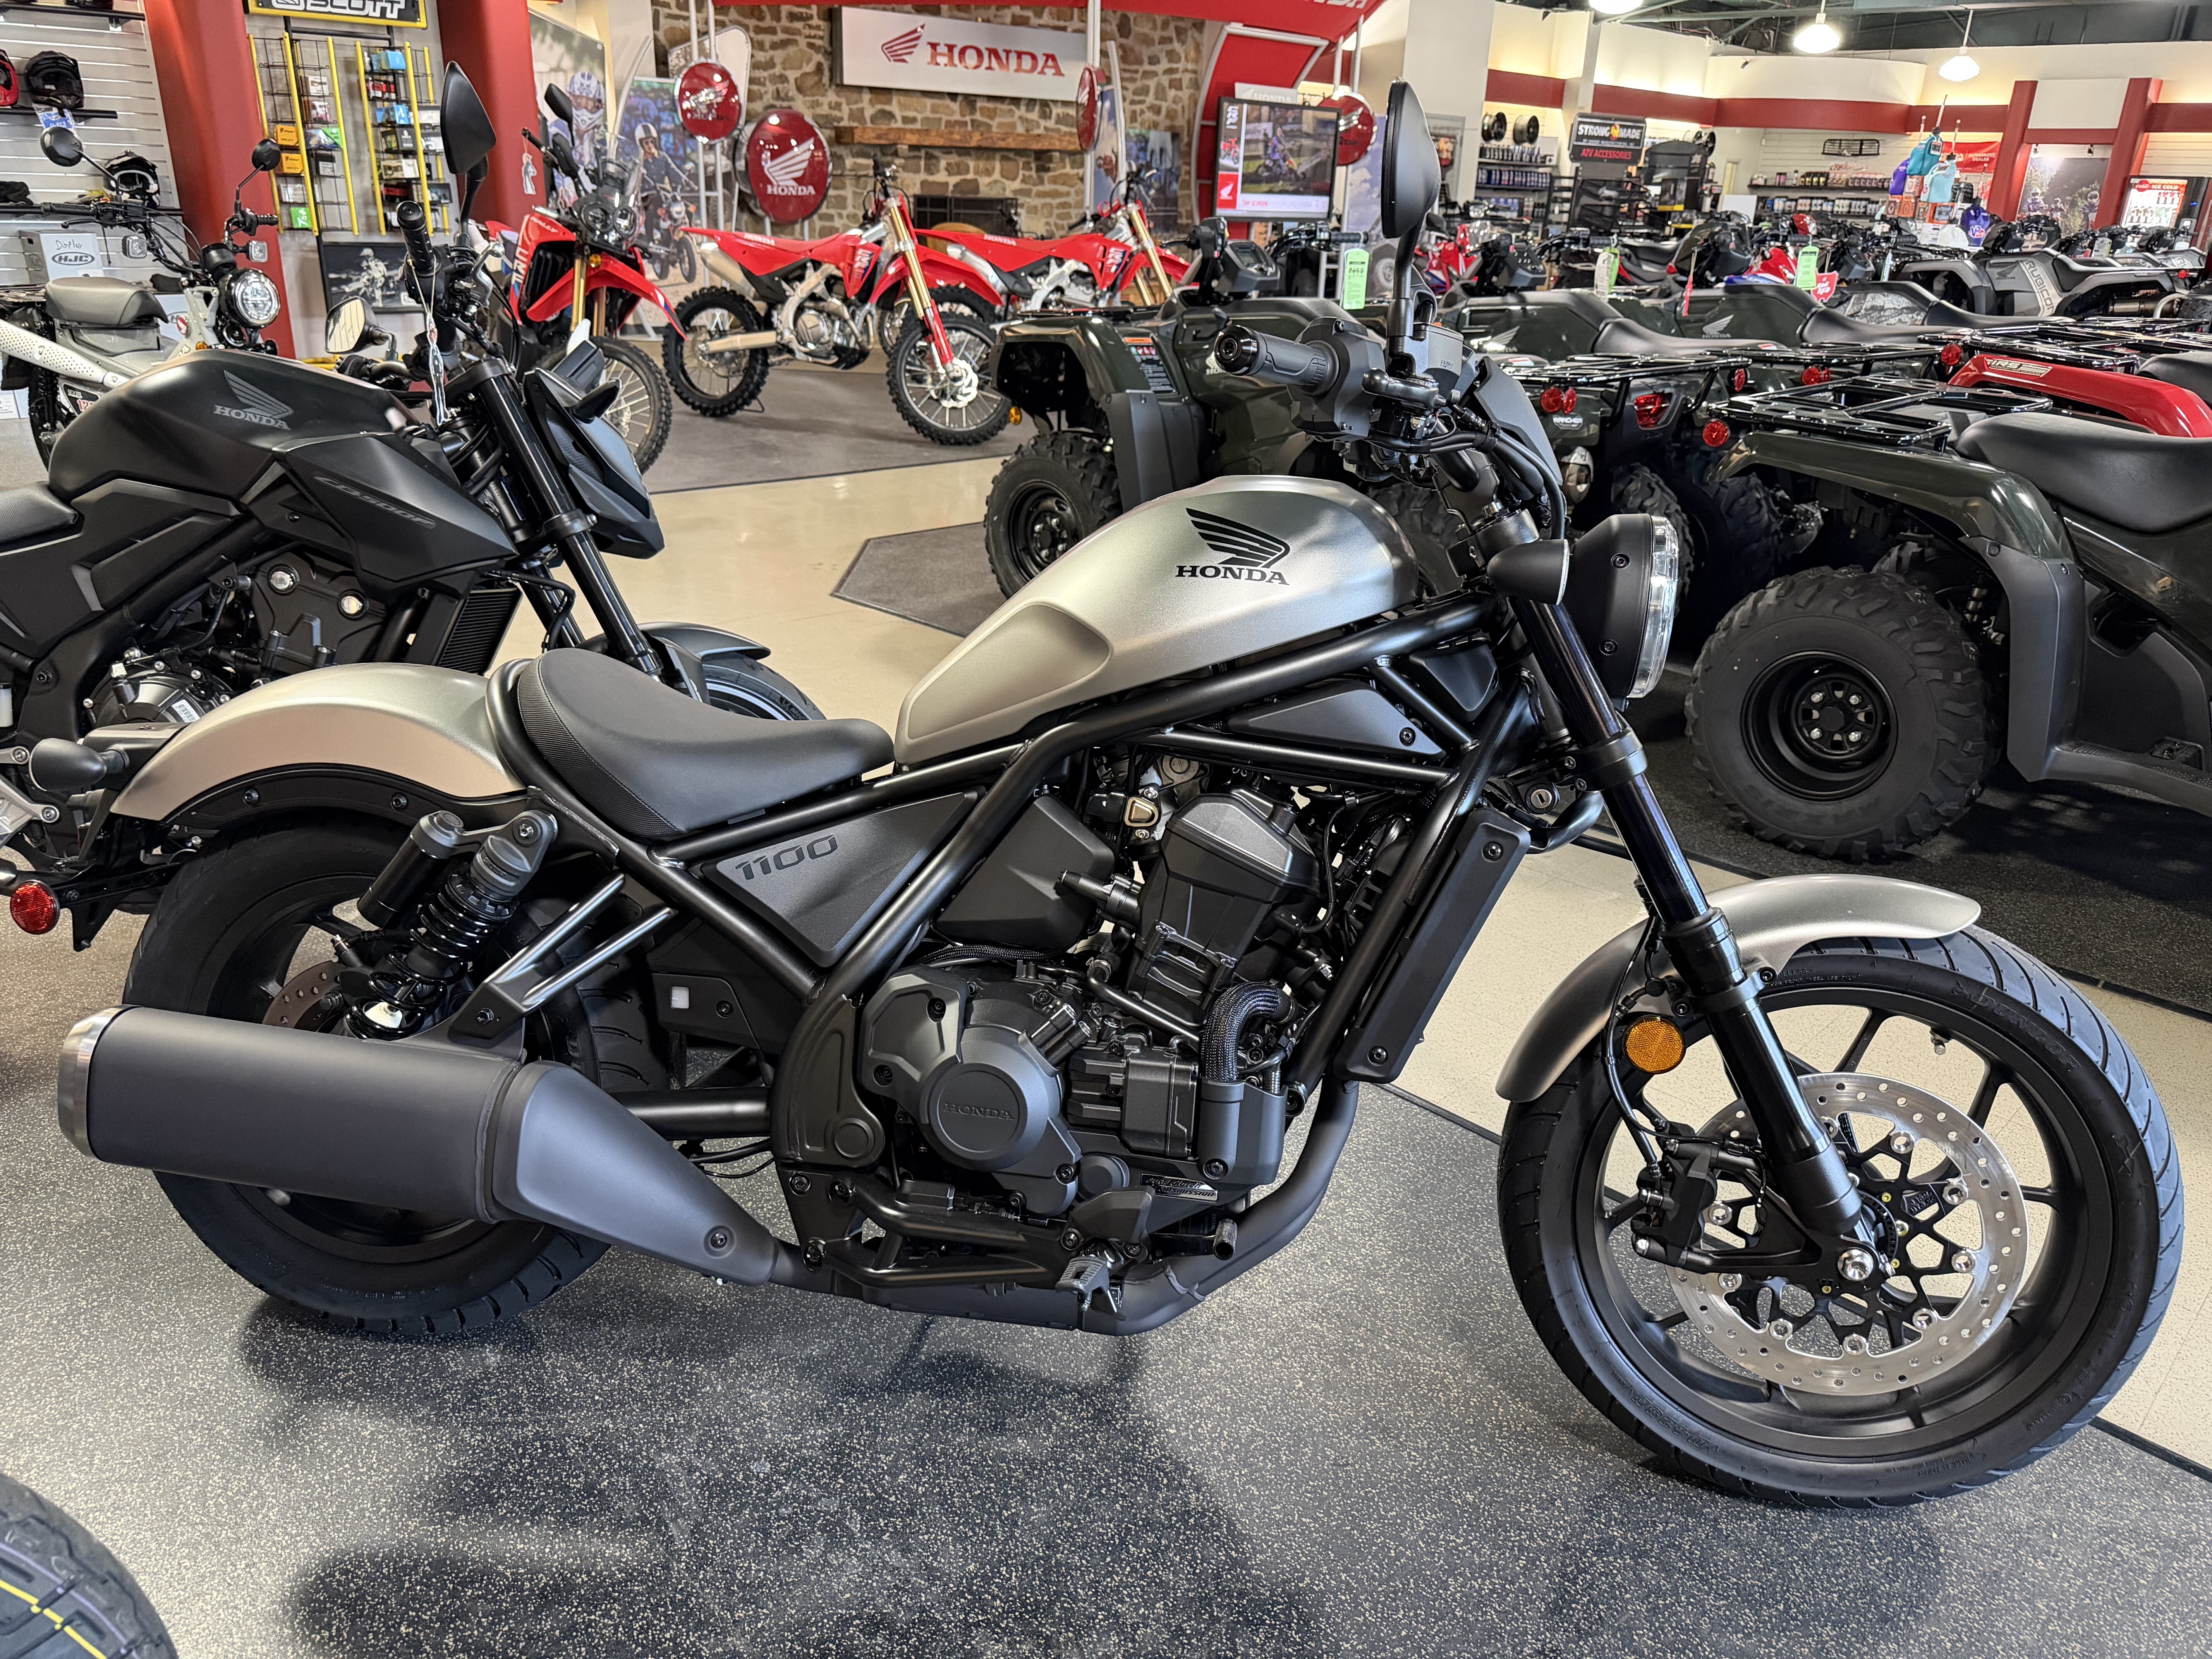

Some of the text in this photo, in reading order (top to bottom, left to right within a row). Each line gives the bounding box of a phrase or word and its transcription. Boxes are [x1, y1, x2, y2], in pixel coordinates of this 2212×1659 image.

[926, 41, 1065, 77] HONDA
[1578, 124, 1642, 139] STRONG MADE
[1581, 148, 1632, 160] ATV ACCESSORIES
[766, 184, 816, 196] HONDA
[984, 234, 1017, 246] HONDA
[2025, 260, 2056, 311] RUBICON
[1990, 360, 2021, 369] IRS
[77, 399, 94, 412] 12
[214, 404, 291, 431] HONDA
[314, 476, 436, 527] CB500F
[1174, 565, 1290, 586] HONDA
[735, 834, 838, 881] 1100
[1969, 993, 2082, 1068] DUNLOP
[943, 1102, 1015, 1121] HONDA
